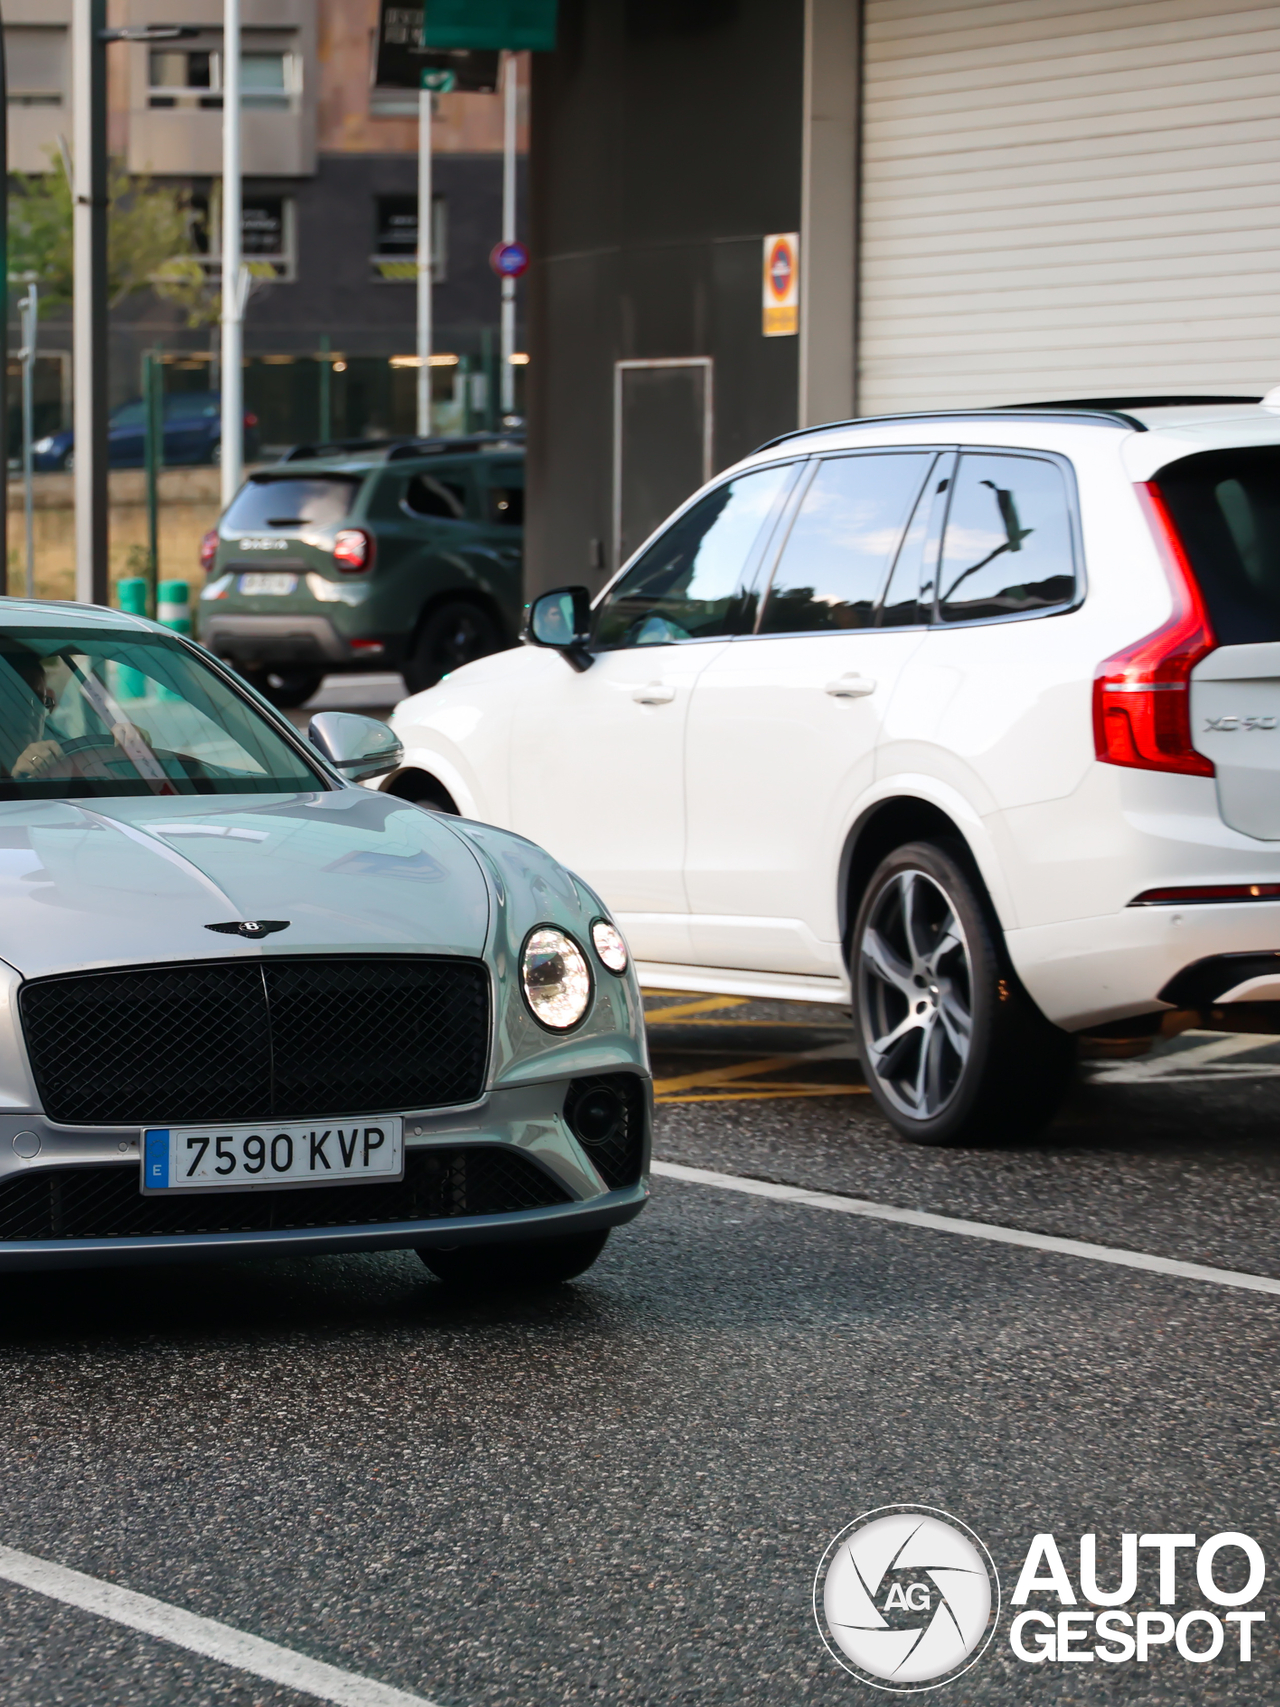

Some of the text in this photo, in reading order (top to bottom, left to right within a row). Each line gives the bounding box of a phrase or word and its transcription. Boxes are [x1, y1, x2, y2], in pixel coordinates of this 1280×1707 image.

[153, 1127, 385, 1177] E 7590 KVP
